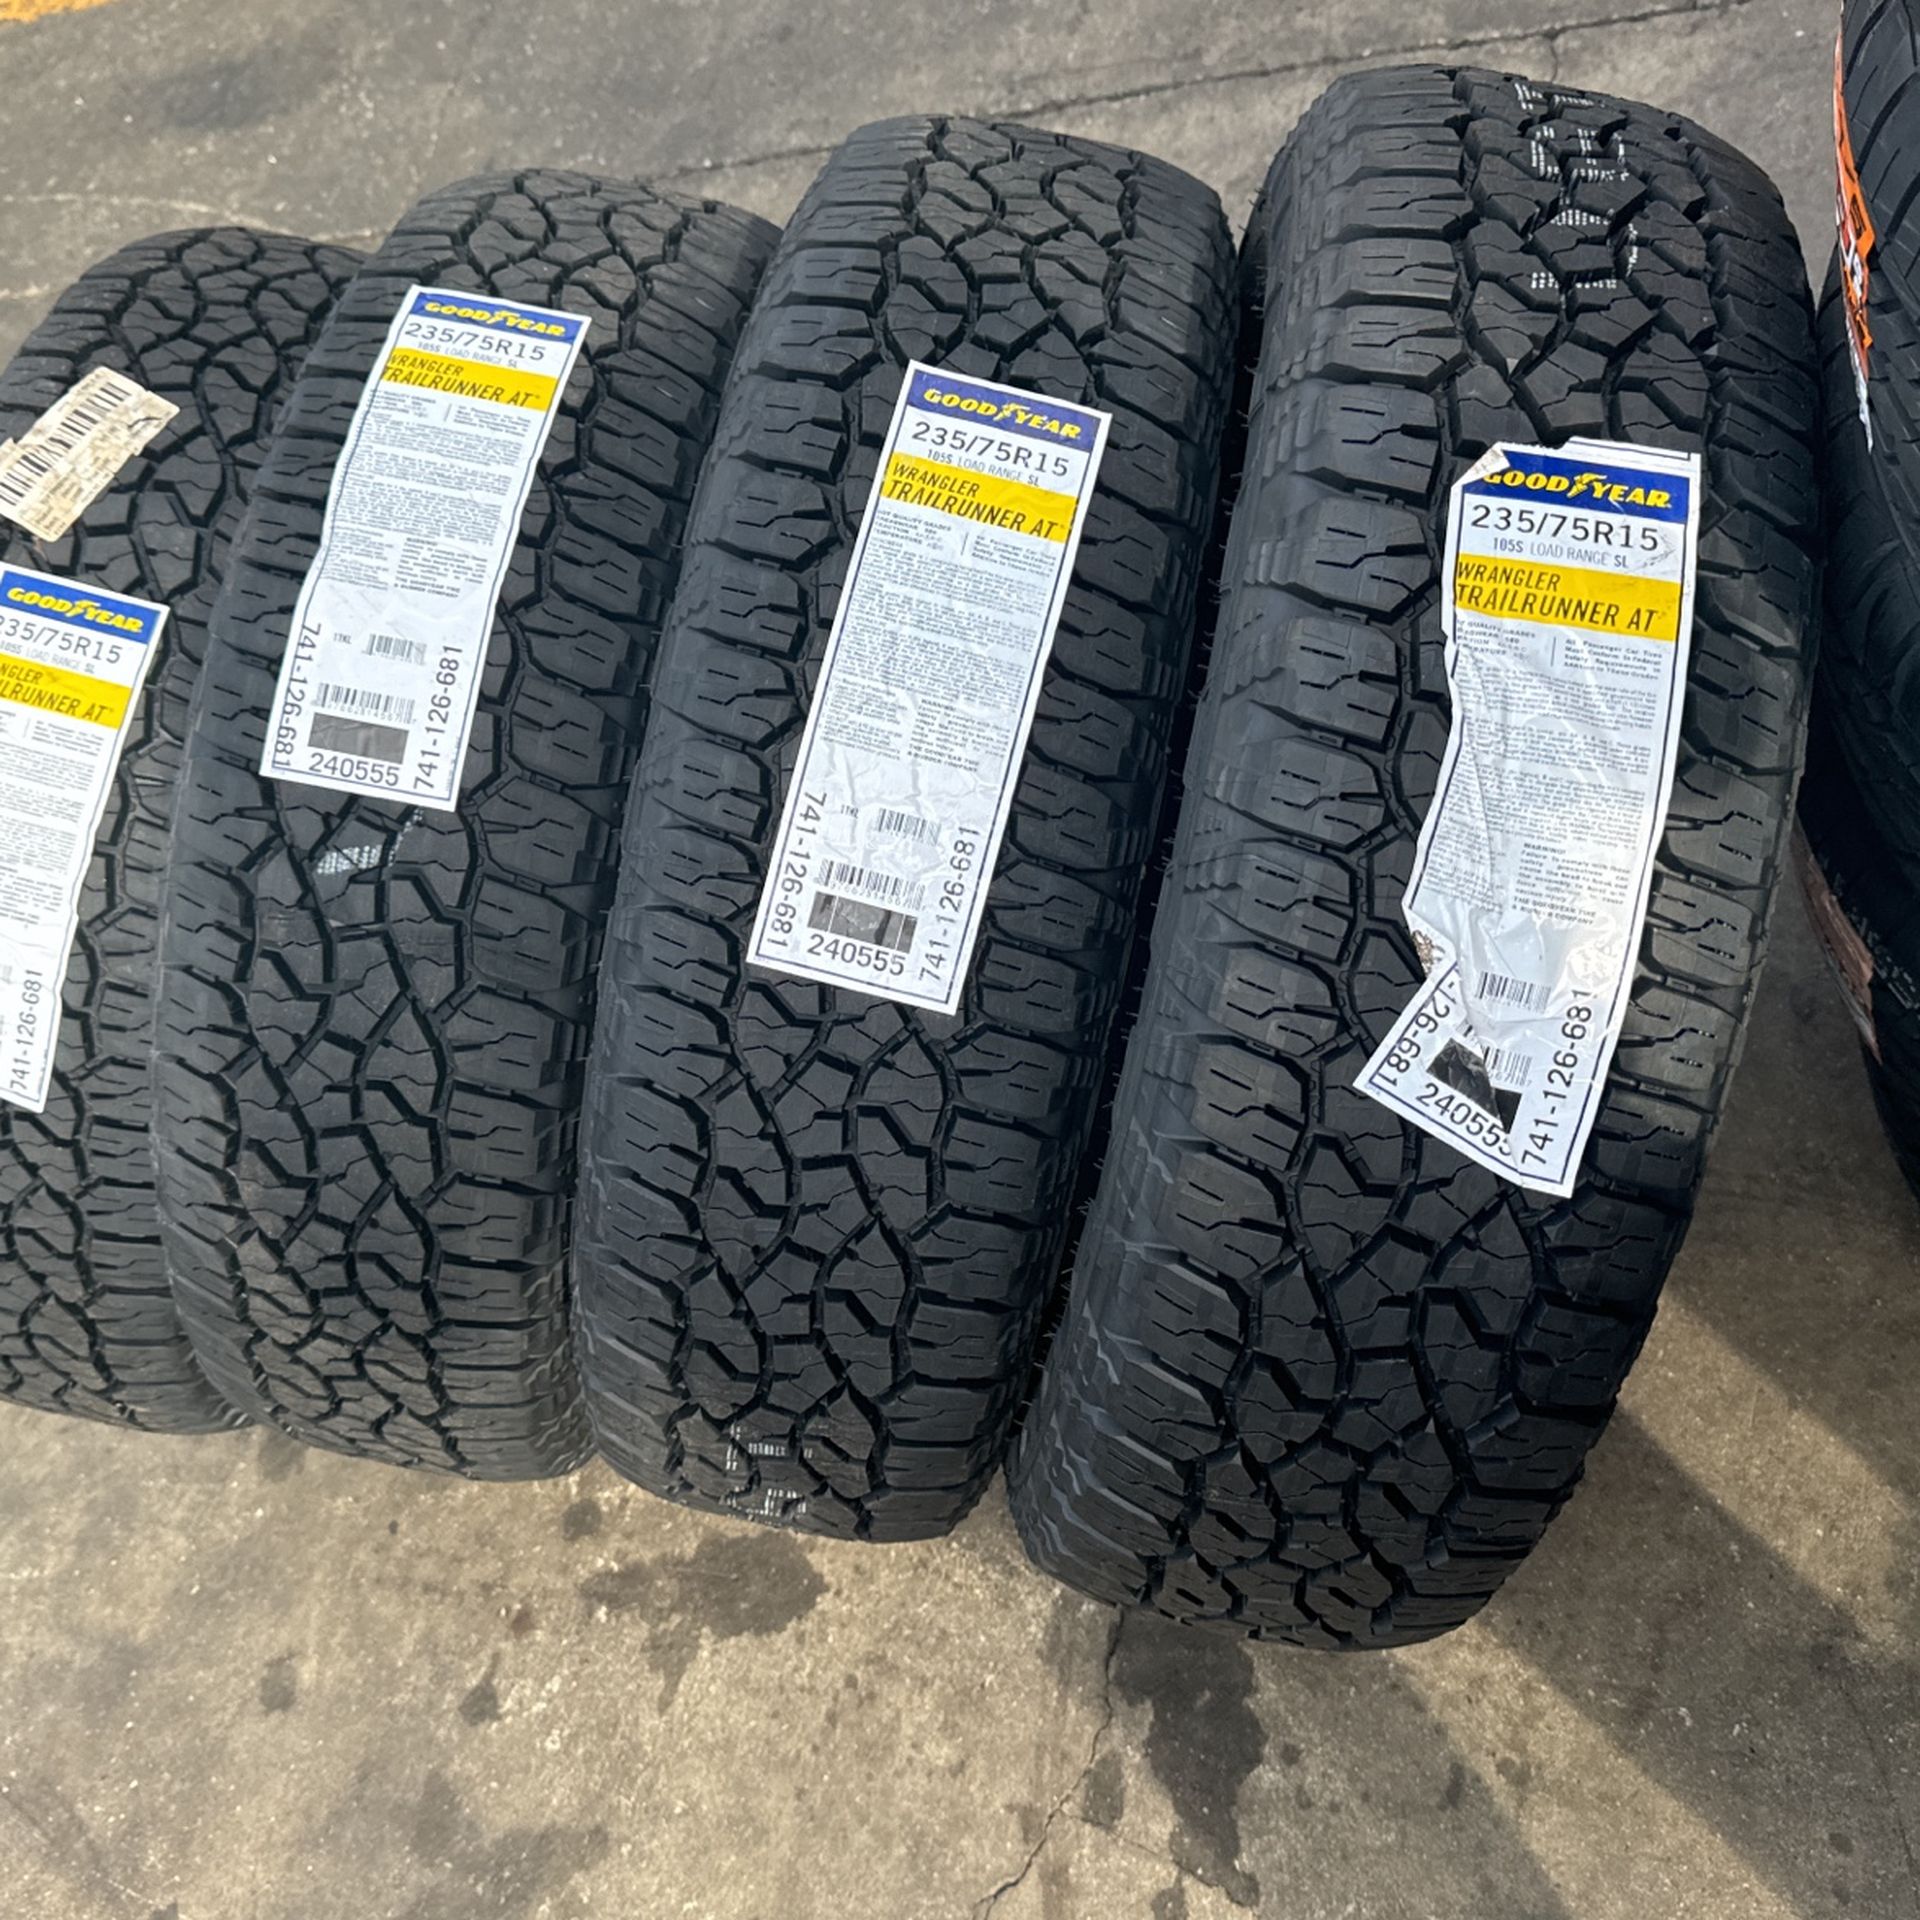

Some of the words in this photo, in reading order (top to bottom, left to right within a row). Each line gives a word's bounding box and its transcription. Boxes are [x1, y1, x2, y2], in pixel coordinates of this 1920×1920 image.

[404, 322, 547, 362] 235/75R15
[424, 302, 566, 337] GOODYEAR
[381, 366, 505, 402] TRAILRUNNER
[389, 353, 464, 377] WRANGLER
[923, 387, 1082, 440] GOODYEAR
[911, 420, 1070, 478] 235/75R15
[927, 448, 953, 465] 105S
[957, 455, 985, 473] LOAD
[988, 462, 1024, 482] RANGE
[1028, 474, 1040, 487] SL
[892, 462, 980, 498] WRANGLER
[886, 479, 1027, 532] TRAILRUNNER
[1470, 504, 1659, 552] 235/75R15
[1492, 536, 1524, 553] 105S
[1530, 541, 1563, 558] LOAD
[1566, 547, 1609, 566] RANGE
[1614, 555, 1629, 568] SL
[1457, 561, 1561, 592] WRANGLER
[7, 587, 144, 633] GOODYEAR
[1456, 583, 1620, 628] TRAILRUNNER
[272, 622, 322, 768] 741-126-681
[413, 644, 464, 791] 741-126-681
[308, 752, 401, 787] 240555
[766, 790, 828, 949] 741-126-681
[918, 825, 981, 983] 741-126-681
[806, 933, 905, 976] 240555
[9, 968, 44, 1092] 741-126-681
[1376, 972, 1459, 1087] -126-681
[1520, 988, 1593, 1166] 741-126-681
